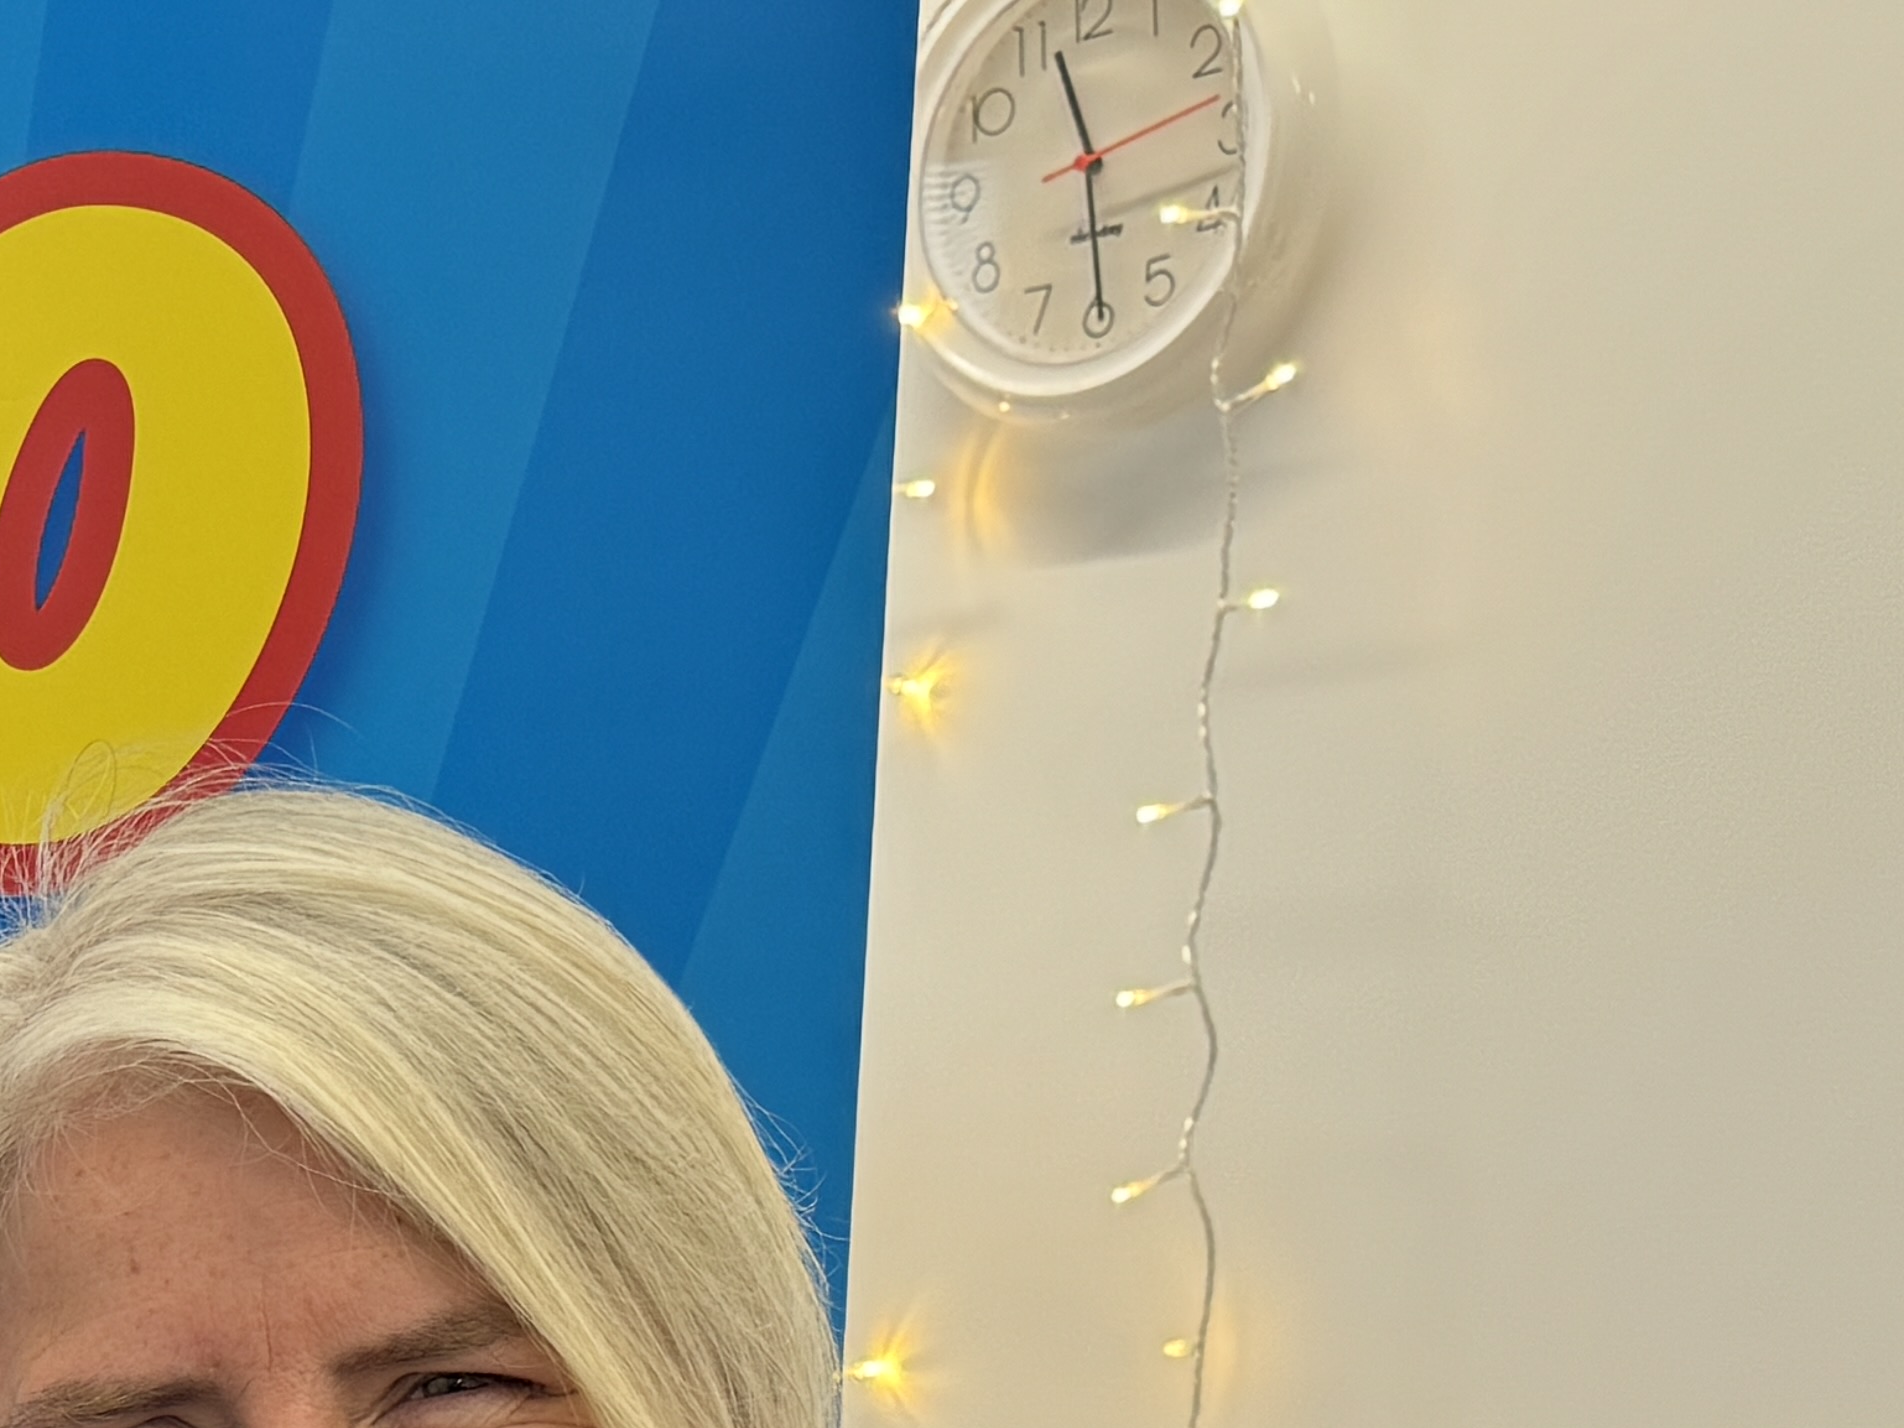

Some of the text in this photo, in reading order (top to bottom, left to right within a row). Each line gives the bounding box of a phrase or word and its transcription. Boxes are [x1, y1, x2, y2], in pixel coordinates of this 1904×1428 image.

[1012, 20, 1047, 78] 11
[1189, 24, 1224, 79] 2
[971, 87, 1016, 144] 10
[950, 173, 981, 225] 9
[972, 241, 1000, 294] 8
[1144, 253, 1176, 307] 5
[1024, 283, 1053, 336] 7
